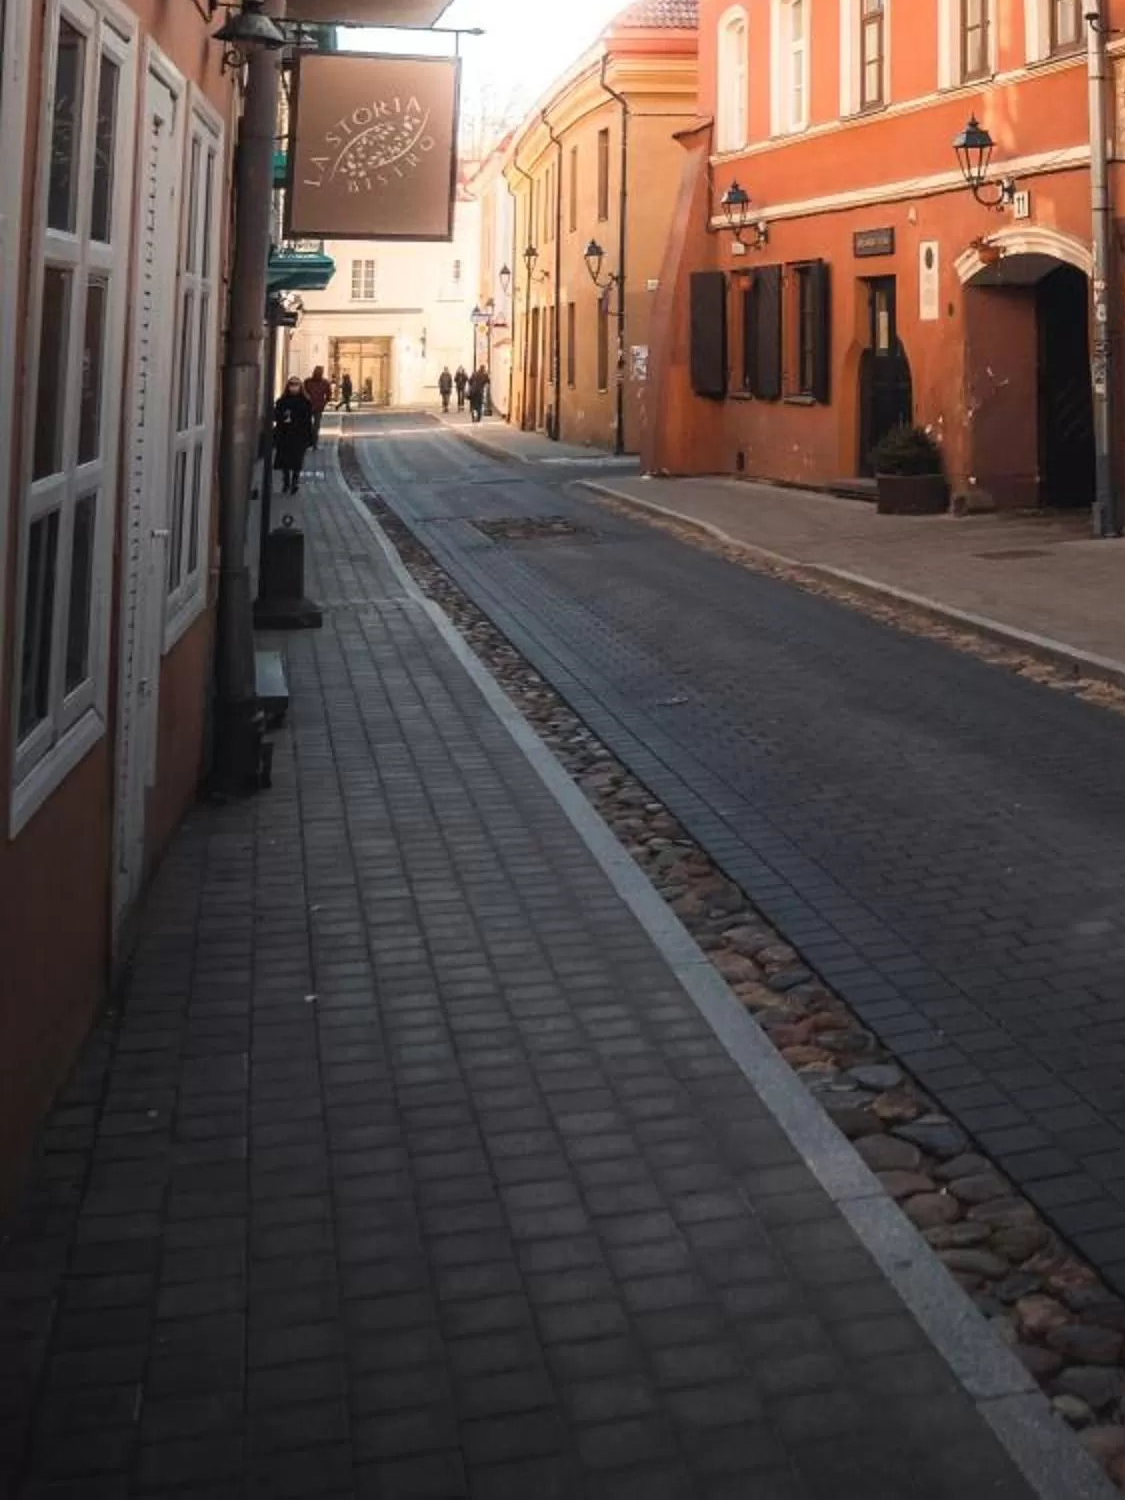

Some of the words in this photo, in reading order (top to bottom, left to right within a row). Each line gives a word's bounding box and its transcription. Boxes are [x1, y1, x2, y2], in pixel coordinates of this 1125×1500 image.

[304, 155, 330, 187] LA
[325, 96, 421, 148] STORIA
[348, 136, 435, 193] BISTRO
[1016, 194, 1025, 215] 11
